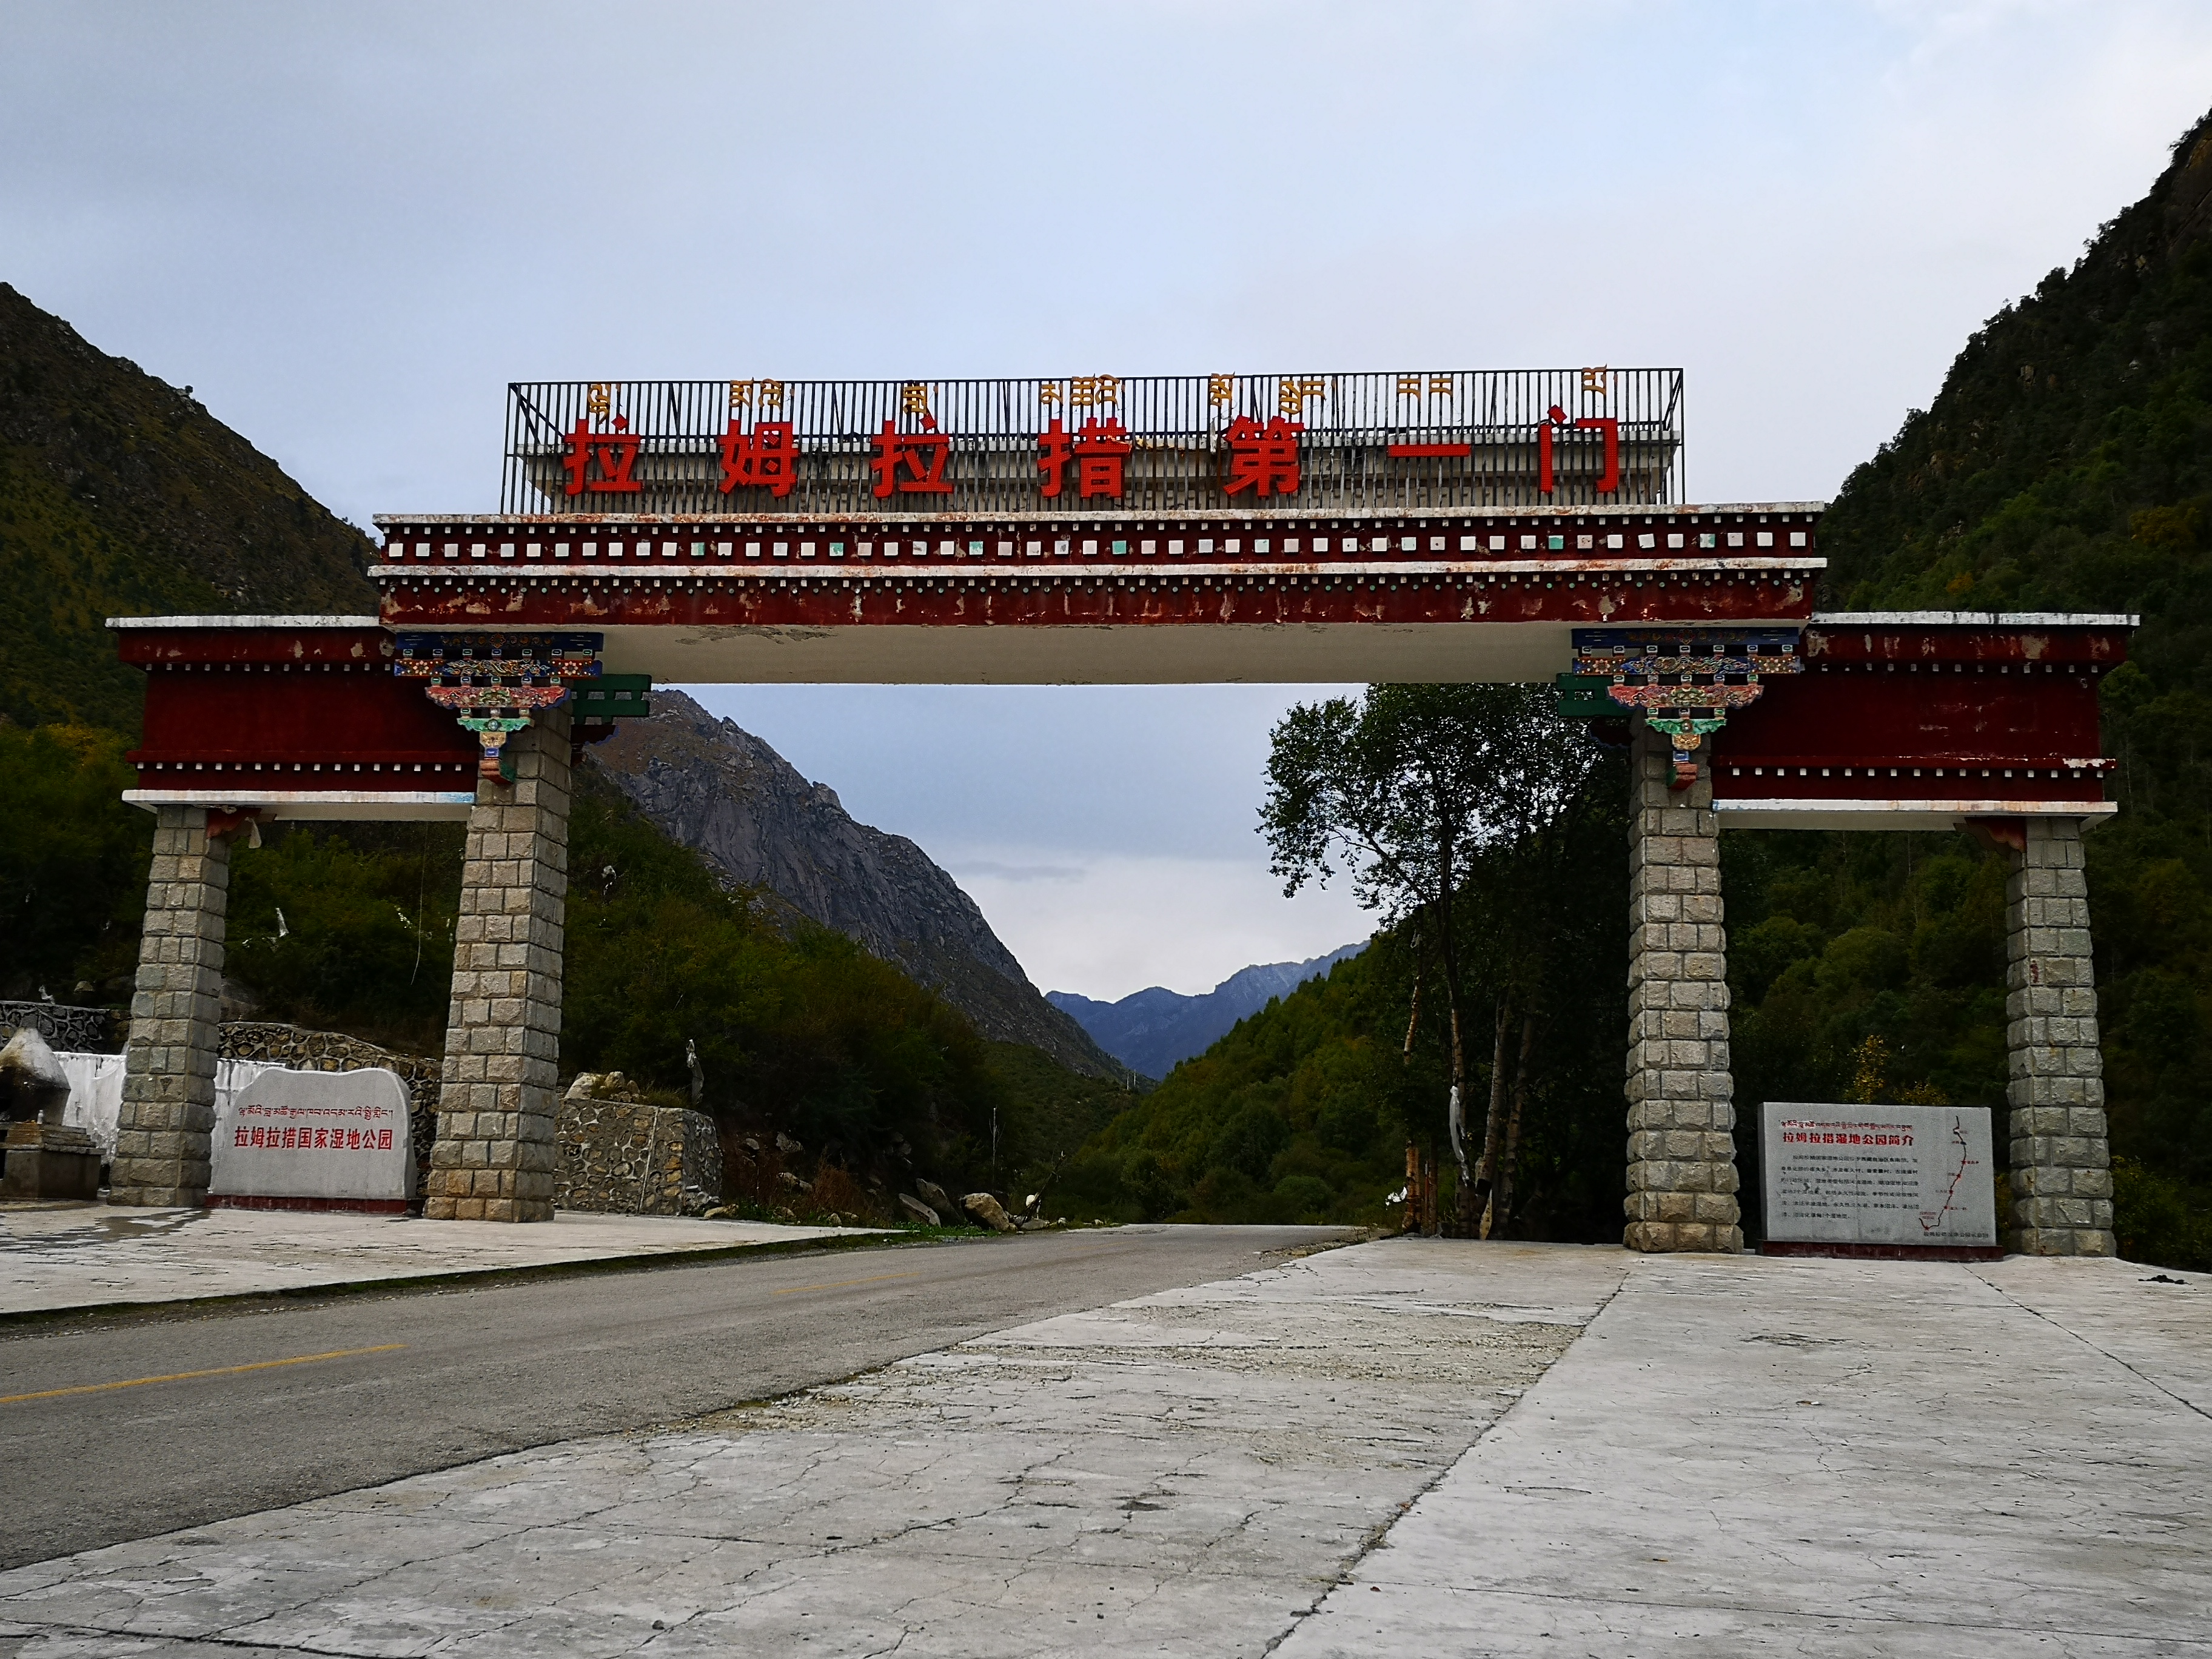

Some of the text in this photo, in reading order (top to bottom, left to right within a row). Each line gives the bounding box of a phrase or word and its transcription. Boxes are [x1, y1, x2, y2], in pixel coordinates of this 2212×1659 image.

[563, 404, 1618, 498] 拉姆拉措第一门
[234, 1126, 393, 1150] 拉姆拉措国家湿地公园
[1783, 1131, 1914, 1146] 拉姆拉措湿地公园简介
